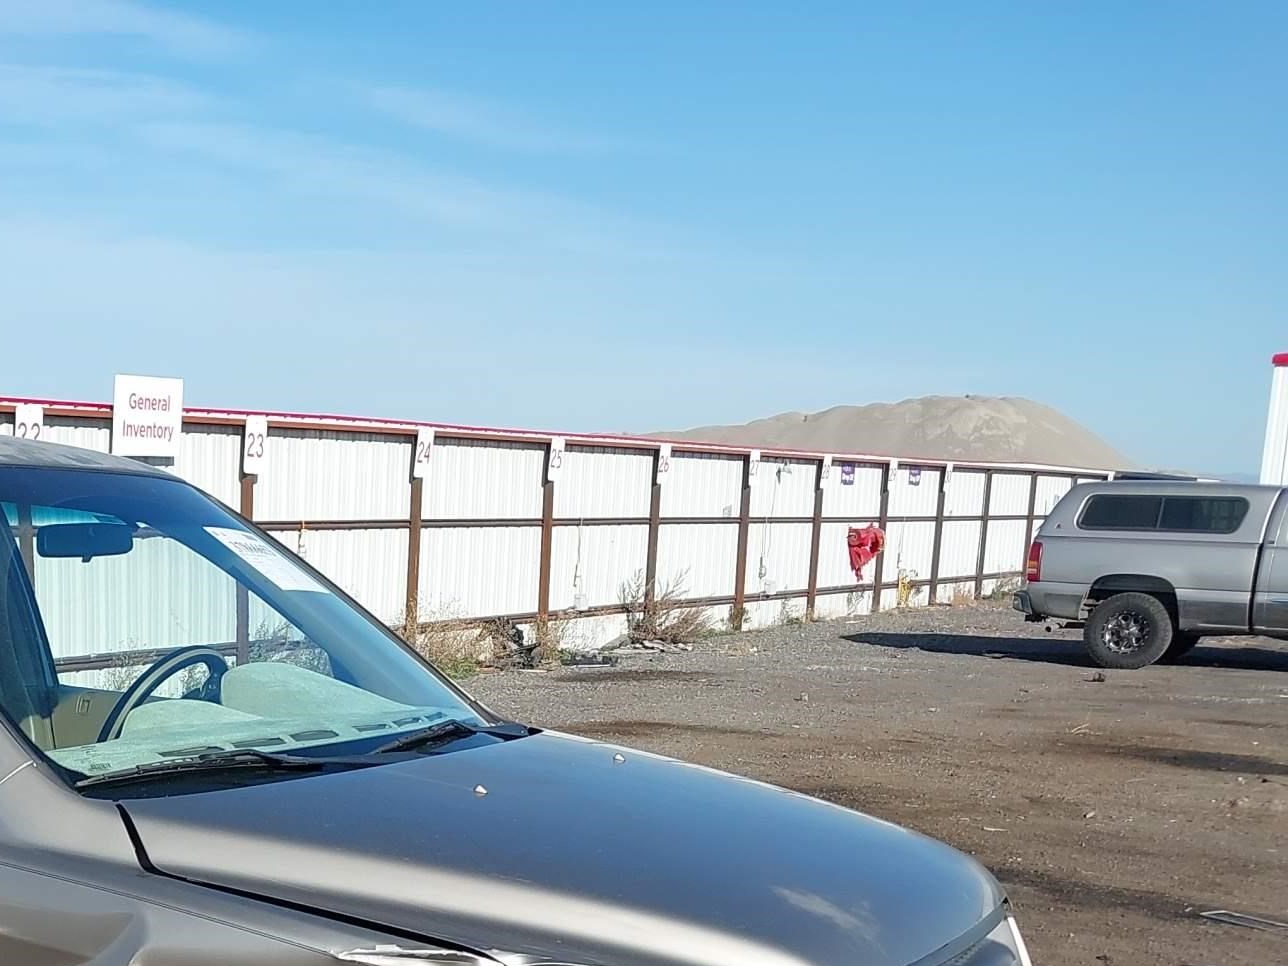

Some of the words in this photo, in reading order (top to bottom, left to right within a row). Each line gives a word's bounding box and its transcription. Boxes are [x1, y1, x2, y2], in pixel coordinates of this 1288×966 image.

[128, 393, 171, 412] General
[122, 420, 174, 442] Inventory
[247, 432, 264, 458] 23
[416, 441, 431, 464] 24
[550, 448, 563, 469] 25
[658, 455, 670, 473] 26
